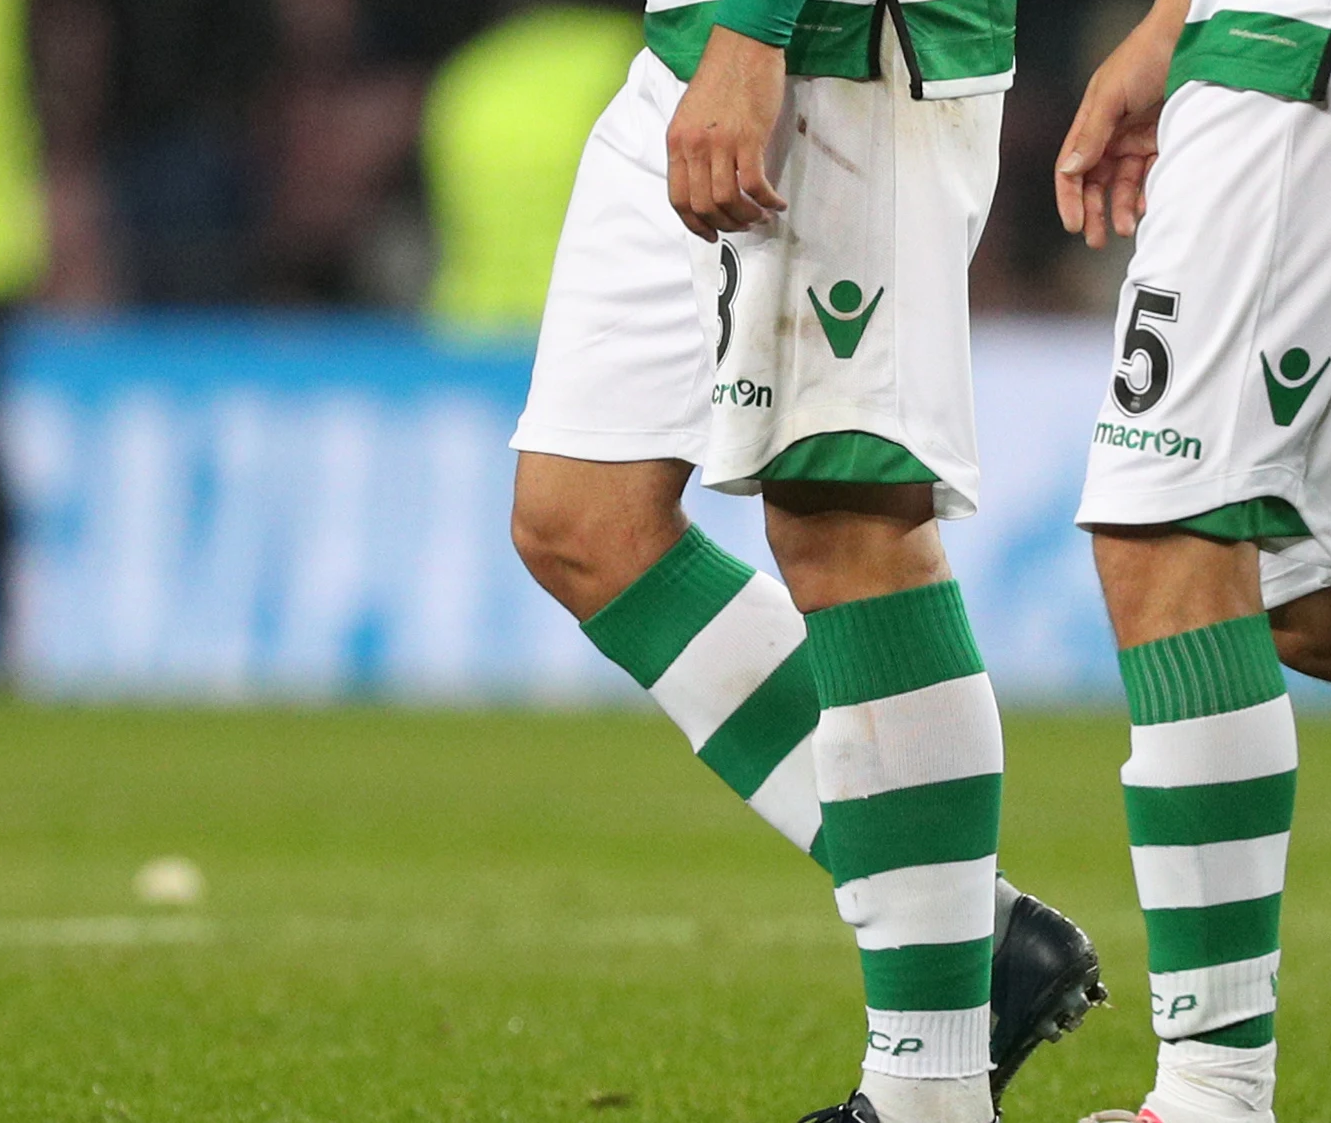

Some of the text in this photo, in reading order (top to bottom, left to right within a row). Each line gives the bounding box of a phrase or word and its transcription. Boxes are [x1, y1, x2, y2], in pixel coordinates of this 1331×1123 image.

[1110, 283, 1180, 418] 5
[712, 379, 772, 408] cron
[1093, 421, 1201, 460] macron
[1152, 992, 1198, 1019] CP
[868, 1030, 924, 1056] CP
